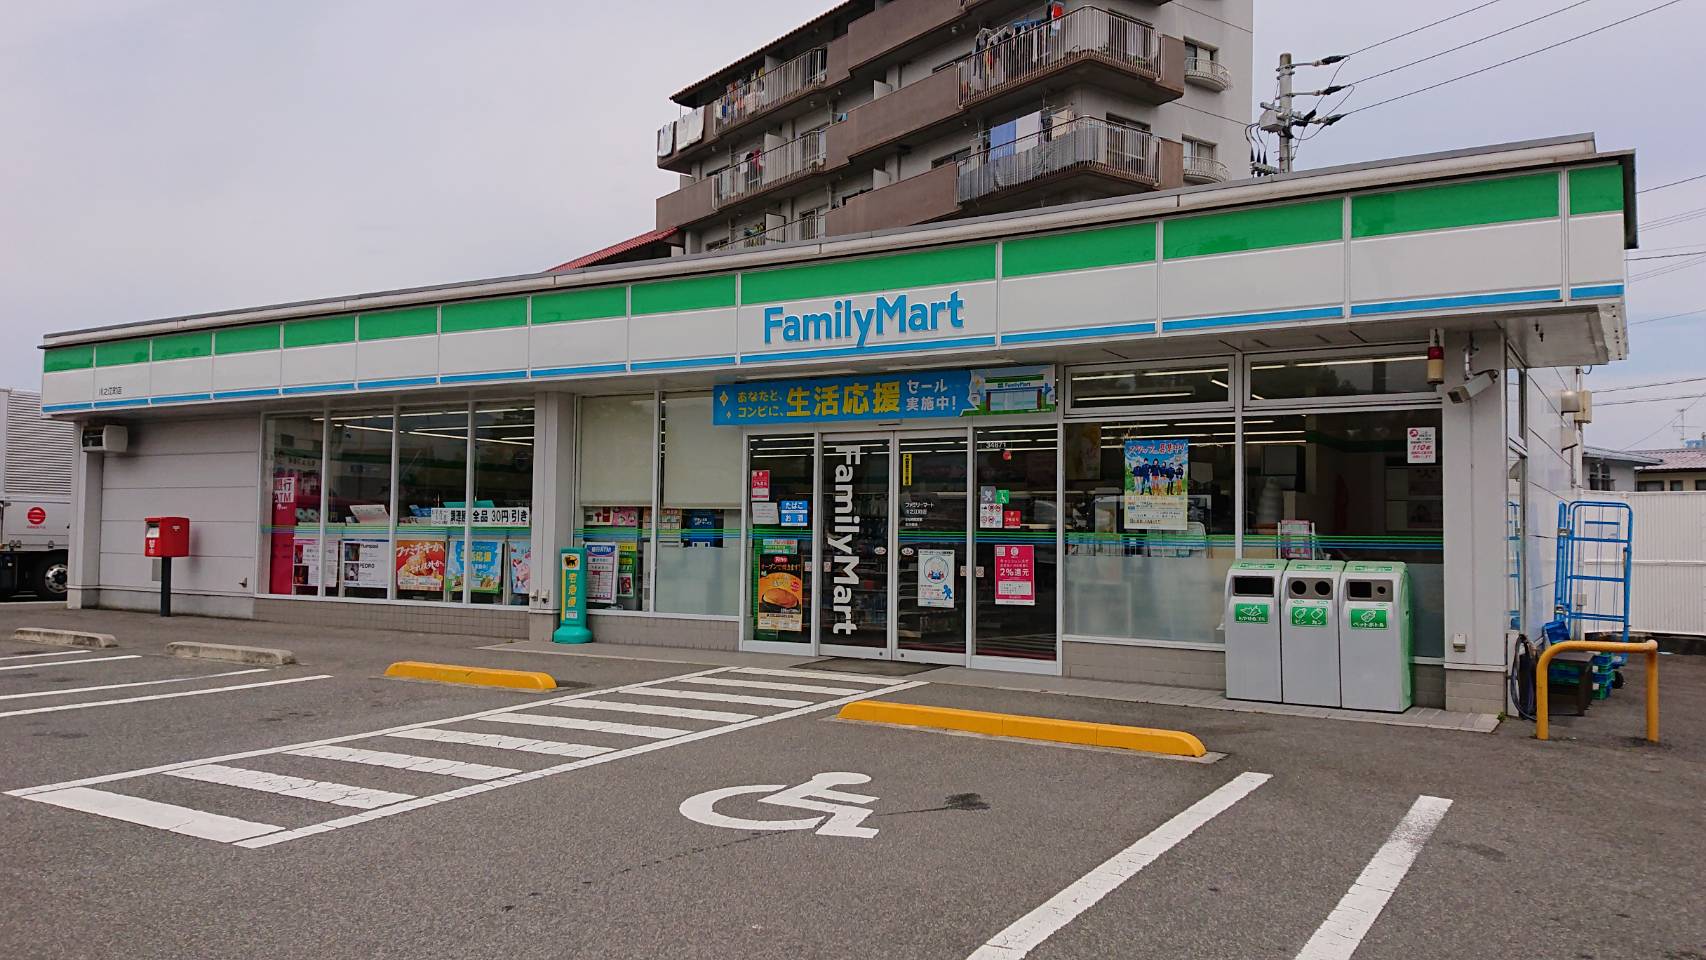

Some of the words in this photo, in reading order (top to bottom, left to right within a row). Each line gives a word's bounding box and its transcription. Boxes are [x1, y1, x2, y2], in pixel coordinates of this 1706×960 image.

[764, 289, 964, 348] FamilyMart
[786, 381, 900, 417] 生活応援
[906, 378, 948, 393] セール
[827, 444, 861, 635] FamilyMart
